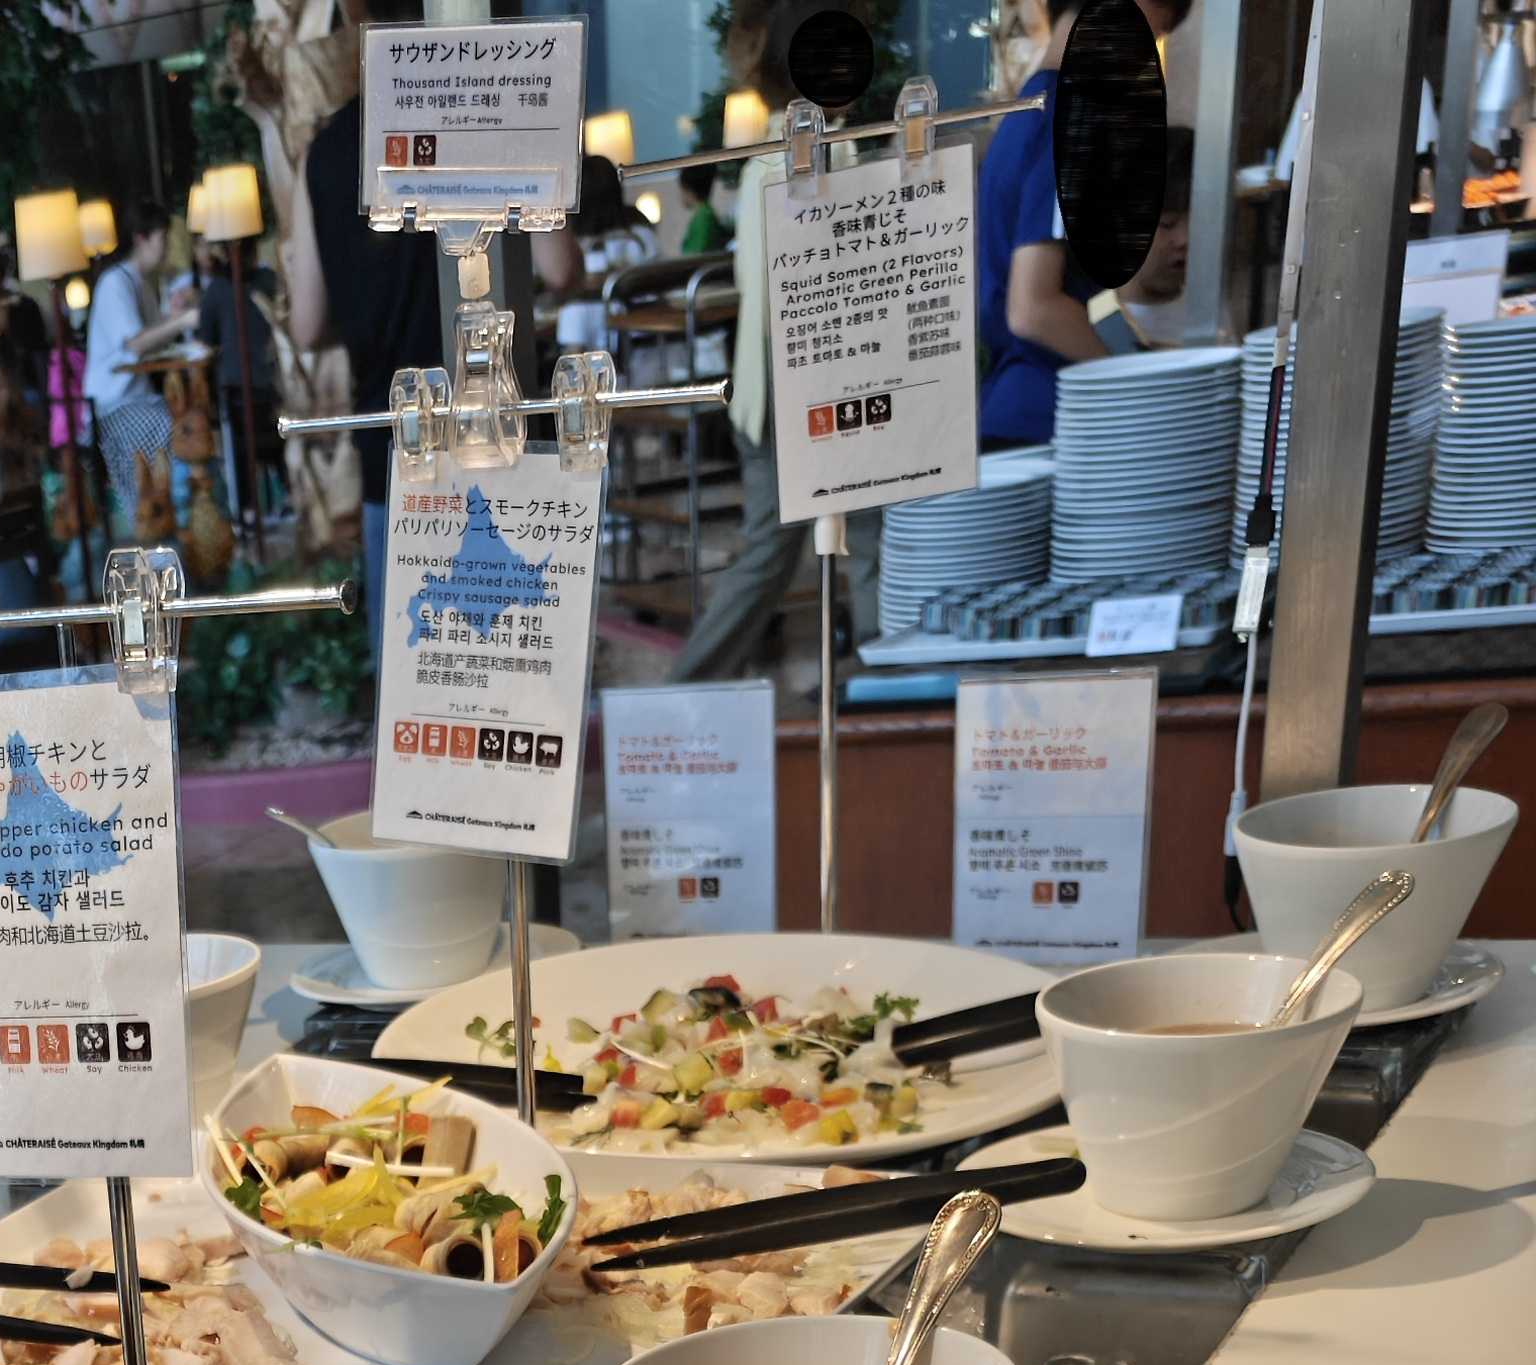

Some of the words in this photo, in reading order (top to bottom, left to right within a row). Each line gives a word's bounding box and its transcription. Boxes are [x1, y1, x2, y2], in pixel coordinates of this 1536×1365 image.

[389, 37, 557, 64] サウザンドレッシング
[392, 77, 451, 90] Thousand
[455, 75, 495, 88] Island
[498, 73, 552, 88] dressing
[395, 96, 424, 110] 사우전
[470, 93, 501, 108] 드레싱
[832, 209, 907, 239] 香味青じそ
[781, 273, 822, 293] Squid
[827, 263, 877, 283] Somen
[882, 258, 897, 274] (2
[901, 245, 964, 268] Flavors)
[786, 283, 854, 307] Aromatic
[859, 273, 904, 291] Green
[910, 262, 959, 281] Perilla
[780, 301, 838, 321] Paccolo
[843, 288, 900, 308] Tomato
[905, 283, 915, 296] &
[920, 274, 966, 293] Garlic
[402, 494, 588, 519] 道産野菜とスモークチキン
[394, 517, 595, 544] パリパリソーセージのサラダ
[397, 554, 507, 572] Hokkaido-grown
[511, 560, 586, 576] vegetables
[421, 573, 446, 585] and
[450, 574, 502, 588] smoked
[506, 577, 558, 591] chicken
[418, 588, 461, 605] Crispy
[464, 591, 519, 608] sausage
[523, 595, 560, 608] salad
[519, 615, 543, 632] 치킨
[447, 629, 471, 645] 파리
[475, 631, 512, 648] 소시지
[50, 816, 123, 834] chicken
[131, 812, 168, 830] and
[30, 840, 93, 859] potato
[100, 834, 153, 852] salad
[4, 870, 35, 891] 후추
[42, 868, 91, 889] 치킨과
[38, 892, 69, 913] 감자
[75, 890, 125, 910] 샐러드
[14, 1000, 61, 1010] アレルギー
[86, 1065, 102, 1075] Soy
[118, 1064, 153, 1073] Chicken
[58, 1139, 91, 1149] Gateaux
[92, 1138, 128, 1151] Kingdom
